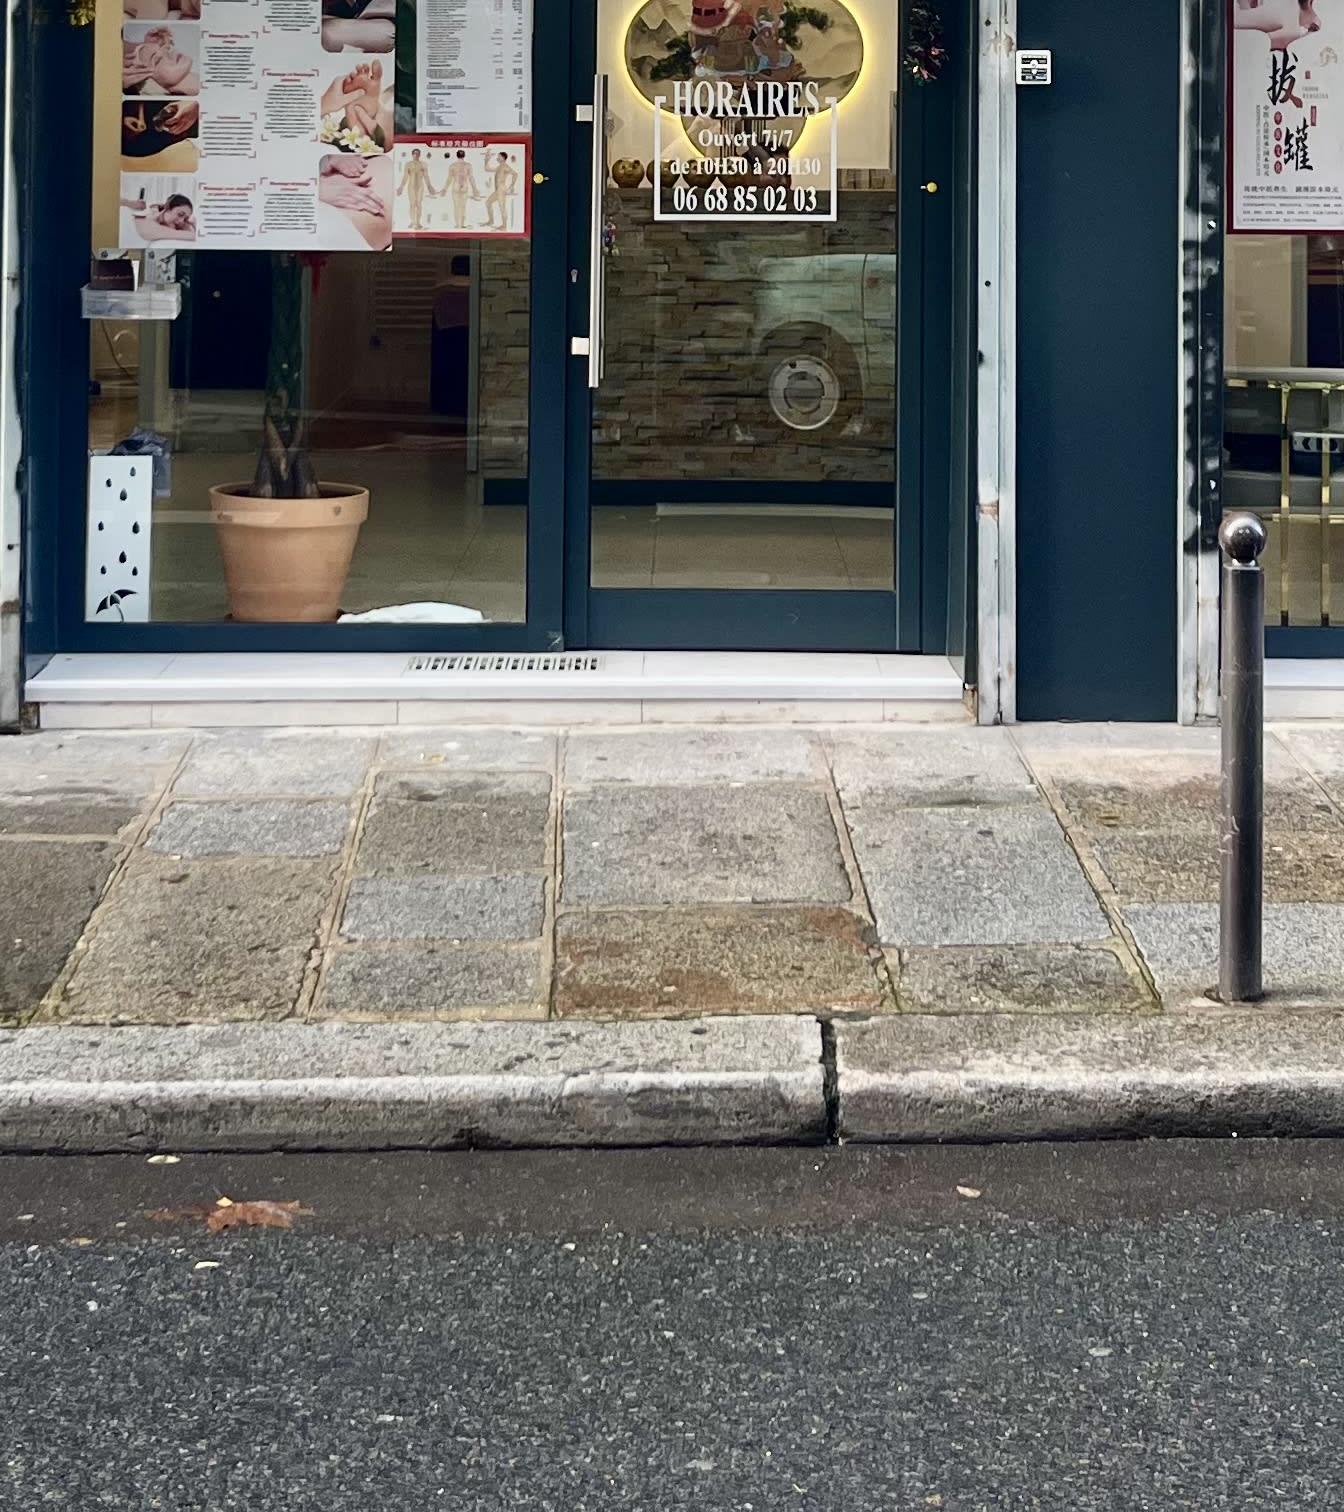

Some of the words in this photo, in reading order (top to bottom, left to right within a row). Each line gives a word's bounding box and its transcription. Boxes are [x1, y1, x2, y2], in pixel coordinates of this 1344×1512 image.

[671, 80, 820, 118] HORAIRES
[1266, 49, 1314, 172] 拔罐
[699, 129, 758, 147] Ouvert
[762, 129, 793, 151] 7j/7
[670, 157, 689, 175] de
[696, 157, 747, 175] 10H30
[753, 158, 762, 175] à
[767, 158, 821, 175] 20H30
[673, 186, 698, 212] 06
[704, 186, 728, 212] 68
[733, 186, 758, 212] 85
[763, 186, 788, 212] 02
[793, 186, 817, 212] 03
